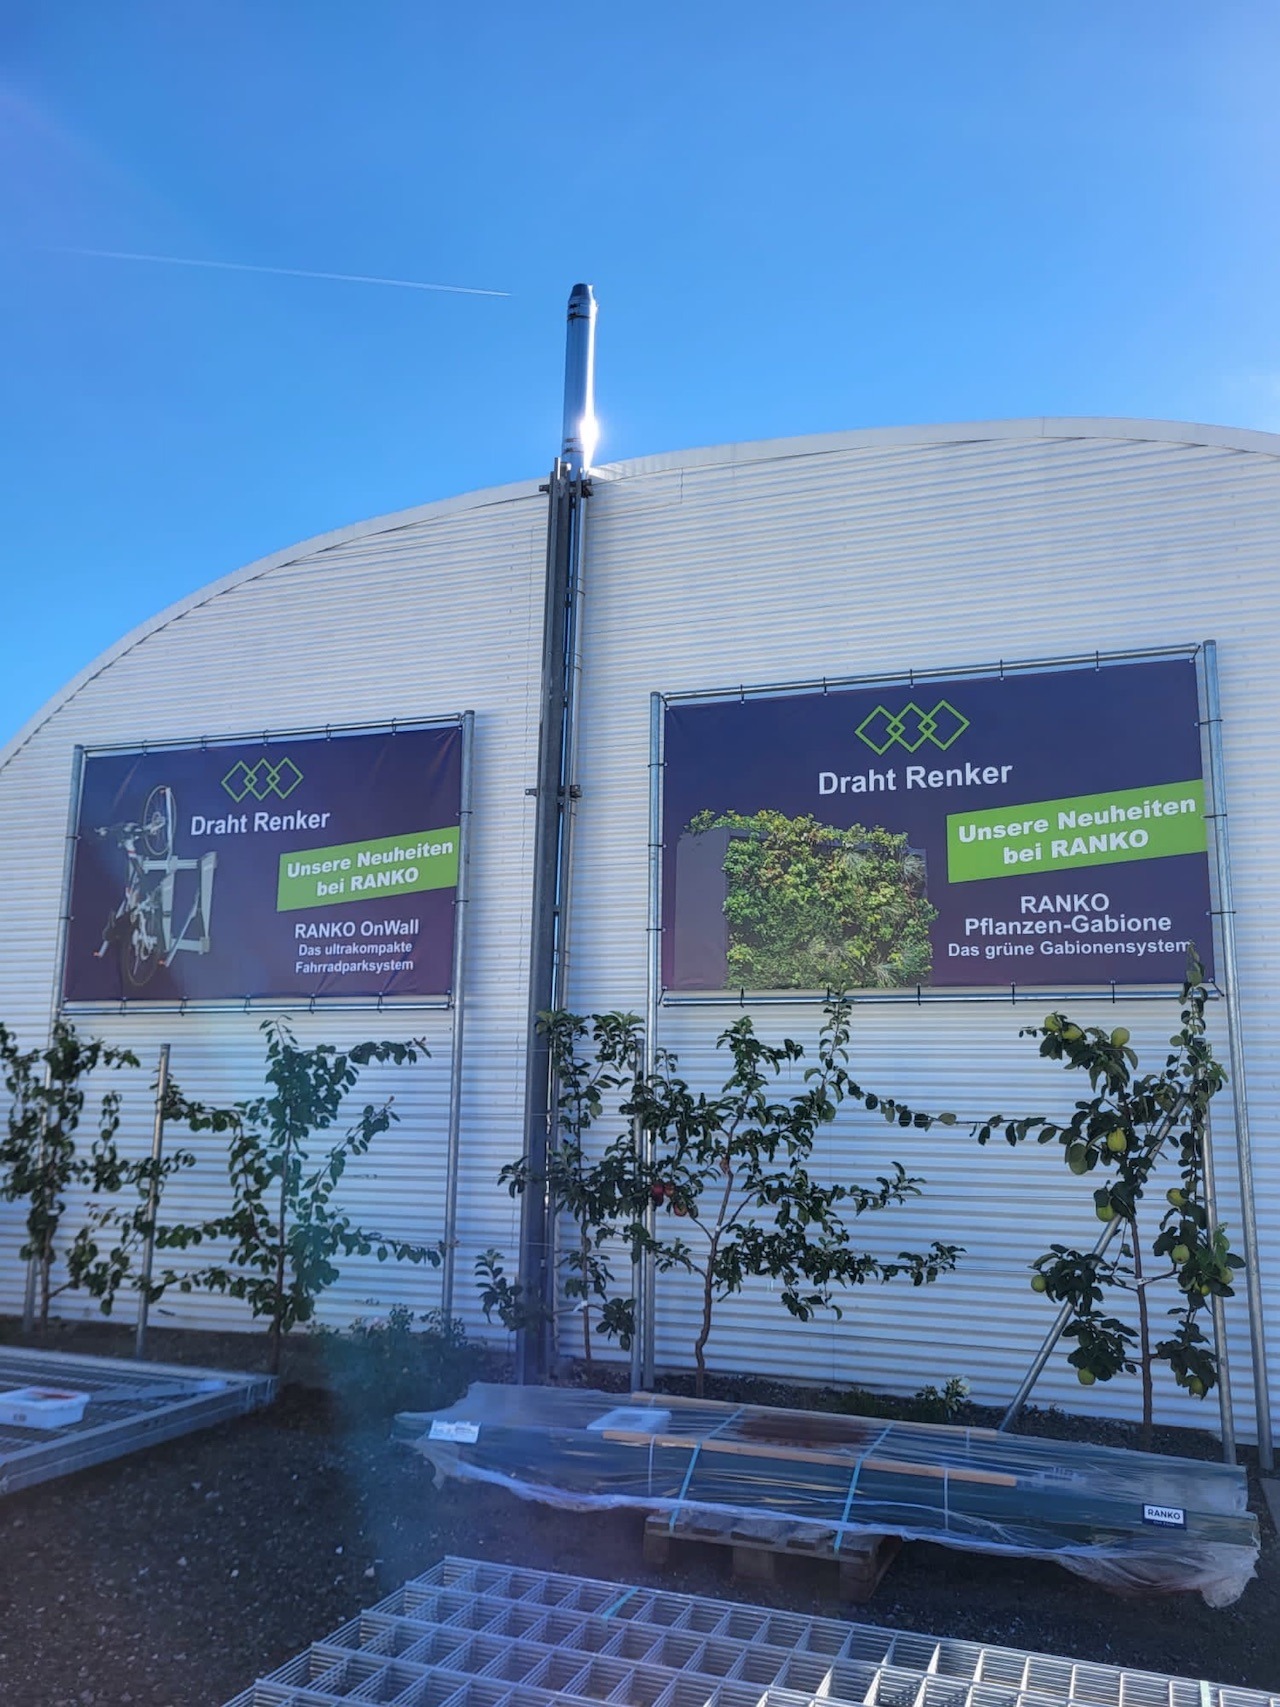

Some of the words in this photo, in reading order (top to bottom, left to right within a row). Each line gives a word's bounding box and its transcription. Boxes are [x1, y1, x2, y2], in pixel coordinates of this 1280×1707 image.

[818, 768, 897, 795] Draht
[905, 762, 1013, 790] Renker
[190, 813, 248, 837] Draht
[253, 810, 330, 833] Renker
[958, 818, 1050, 844] Unsere
[1057, 797, 1196, 830] Neuheiten
[1003, 845, 1042, 865] bei
[1051, 829, 1149, 859] RANKO
[287, 857, 351, 878] Unsere
[357, 841, 453, 868] Neuheiten
[316, 878, 345, 898] bei
[350, 867, 419, 891] RANKO
[1020, 893, 1109, 914] RANKO
[294, 921, 356, 940] RANKO
[360, 919, 420, 938] OnWall
[965, 913, 1172, 936] Pflanzen-Gabione
[298, 943, 321, 957] Das
[325, 941, 412, 957] ultrakompakte
[948, 942, 980, 958] Das
[985, 940, 1035, 960] grüne
[1040, 938, 1191, 957] Gabionensystem
[295, 959, 414, 976] Fahrradparksystem
[1148, 1508, 1180, 1519] RANKO
